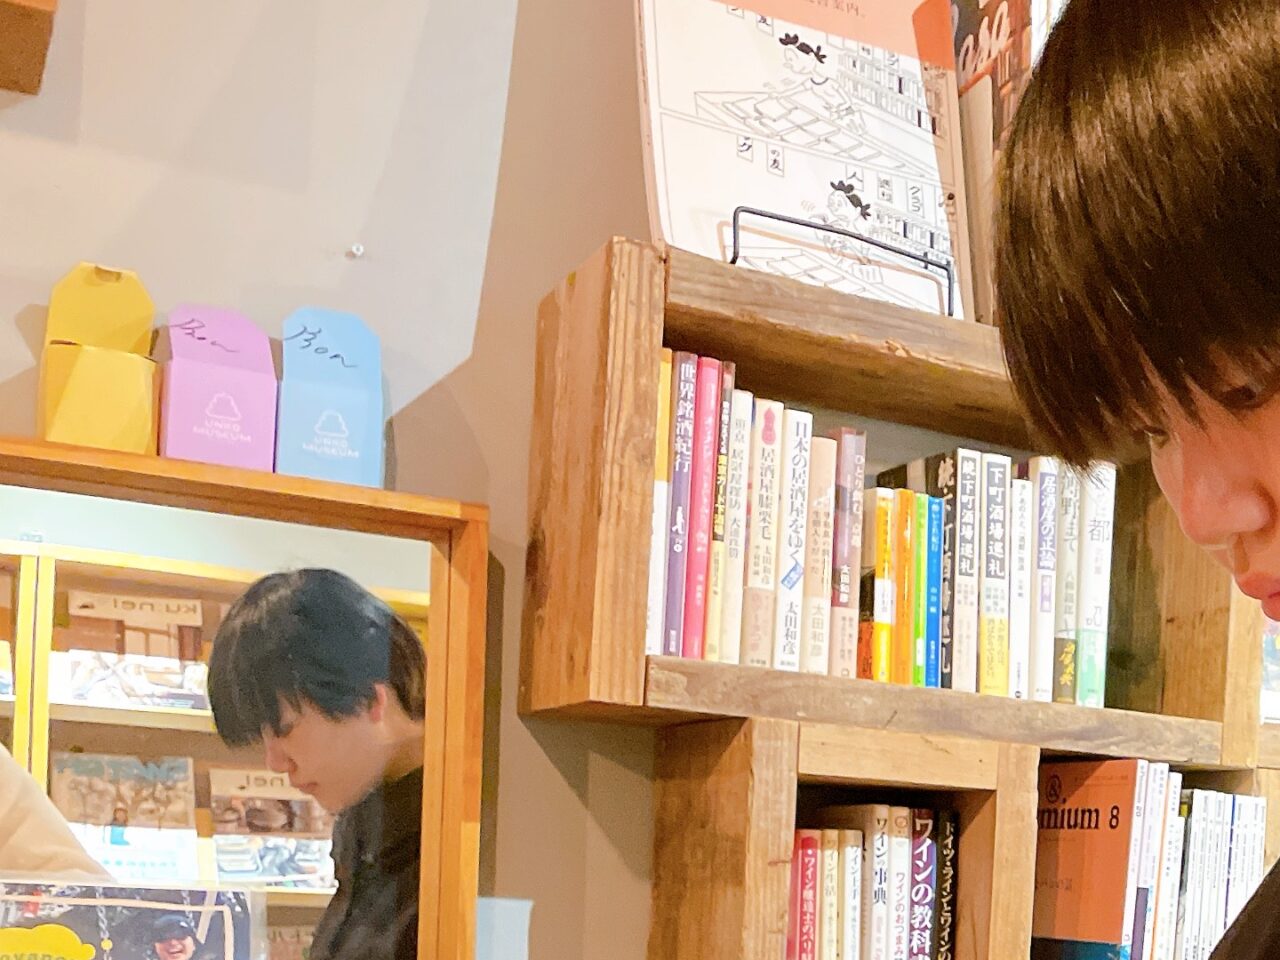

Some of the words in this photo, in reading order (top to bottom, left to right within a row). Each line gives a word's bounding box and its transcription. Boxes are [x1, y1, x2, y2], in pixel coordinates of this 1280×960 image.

[192, 425, 252, 442] MUSEUM
[302, 441, 360, 459] MUSEUM
[787, 421, 808, 564] 日本の居酒屋をゆく
[988, 466, 1005, 577] 下町酒場巡礼
[1039, 475, 1056, 569] 居酒屋の正論
[782, 601, 799, 656] 太田和彦
[1039, 807, 1100, 830] mium
[1108, 804, 1120, 830] 8
[873, 817, 888, 905] ワインの事典
